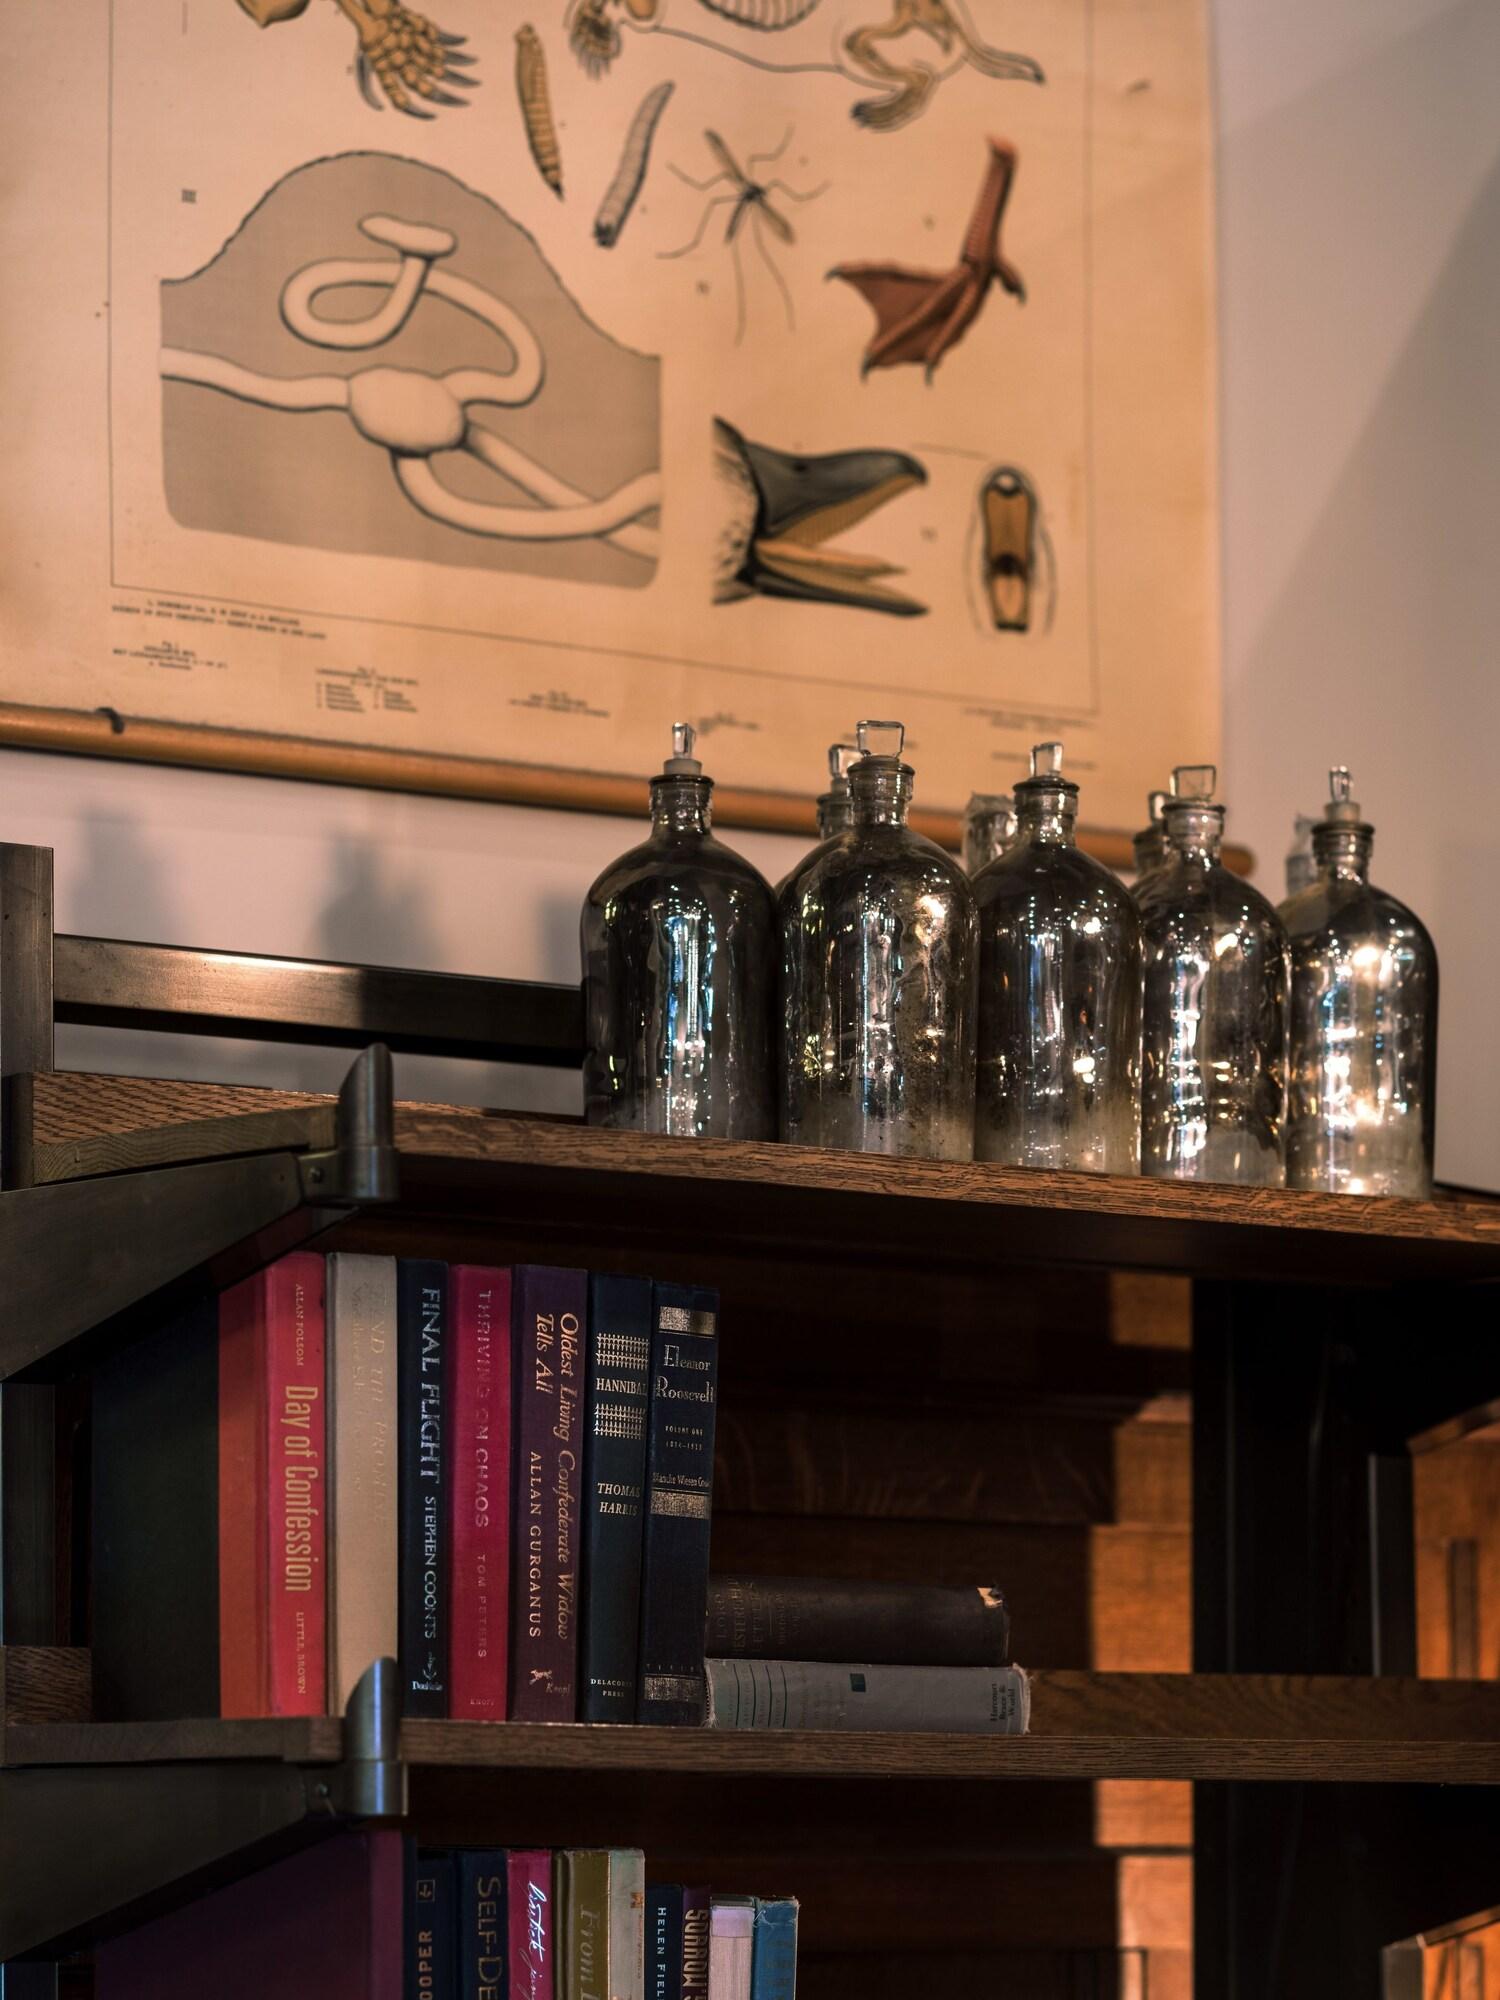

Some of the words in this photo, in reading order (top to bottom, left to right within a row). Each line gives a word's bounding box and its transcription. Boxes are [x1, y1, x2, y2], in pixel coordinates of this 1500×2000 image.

[295, 1284, 305, 1319] ALLAN
[295, 1322, 305, 1366] FOLSOM
[420, 1288, 441, 1372] FINAL
[475, 1290, 492, 1397] THRIVING
[535, 1313, 555, 1352] Tells
[559, 1313, 580, 1376] Oldest
[533, 1357, 554, 1393] All
[664, 1344, 711, 1371] Eleanor
[279, 1386, 319, 1428] Day
[596, 1377, 648, 1396] HANNIBAL
[656, 1376, 714, 1402] Roosevelt
[420, 1383, 441, 1484] FLIGHT
[475, 1407, 491, 1440] ON
[552, 1384, 579, 1442] Living
[283, 1436, 319, 1457] of
[473, 1447, 490, 1528] CHAOS
[528, 1452, 543, 1516] ALLAN
[551, 1450, 577, 1564] Confederate
[597, 1482, 640, 1498] THOMAS
[282, 1465, 319, 1592] Confession
[423, 1495, 438, 1565] STEPHEN
[599, 1501, 638, 1517] HARRIS
[477, 1554, 487, 1587] TOM
[528, 1525, 543, 1638] GURGANUS
[423, 1570, 438, 1639] COONTS
[477, 1594, 487, 1658] PETERS
[556, 1573, 575, 1641] Widow
[295, 1653, 306, 1695] BROWN
[580, 1904, 601, 1982] From
[657, 1907, 667, 1955] HELEN
[657, 1963, 667, 2000] FIEL
